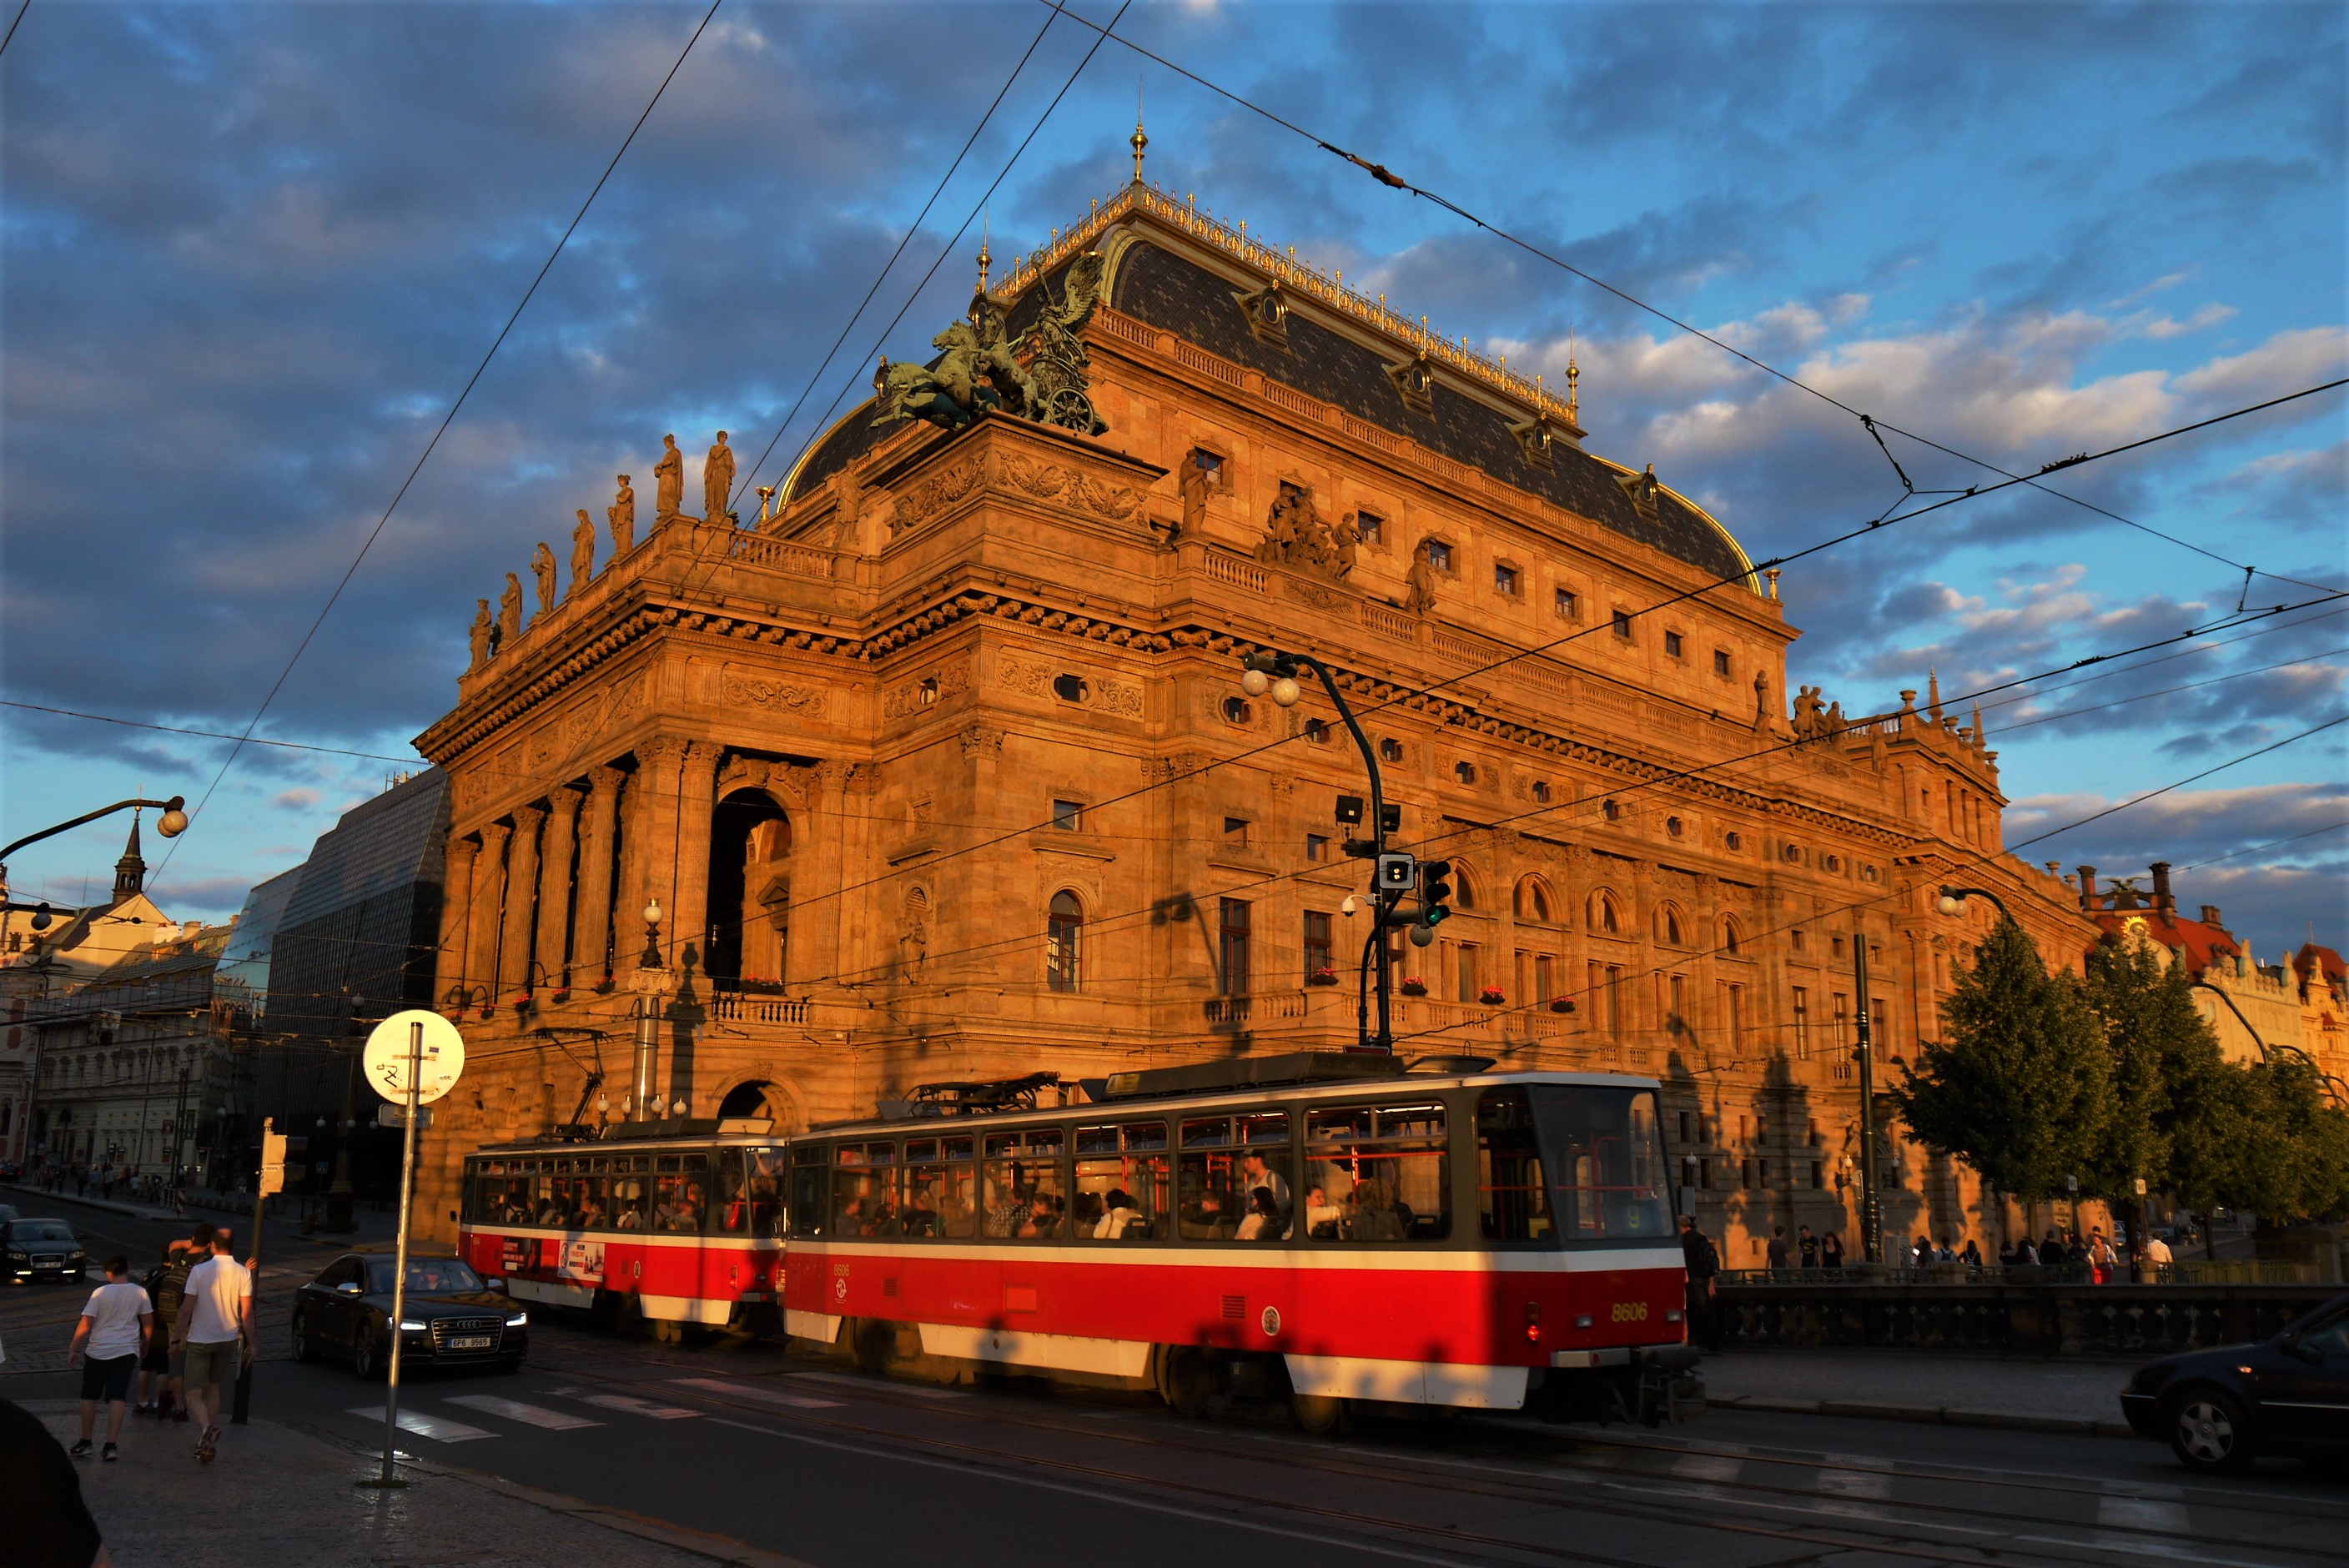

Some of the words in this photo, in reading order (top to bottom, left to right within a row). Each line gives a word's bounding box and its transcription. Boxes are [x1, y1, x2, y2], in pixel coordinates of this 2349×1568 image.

[1628, 1206, 1641, 1229] 9
[834, 1264, 849, 1276] 8606
[1611, 1302, 1648, 1323] 8606
